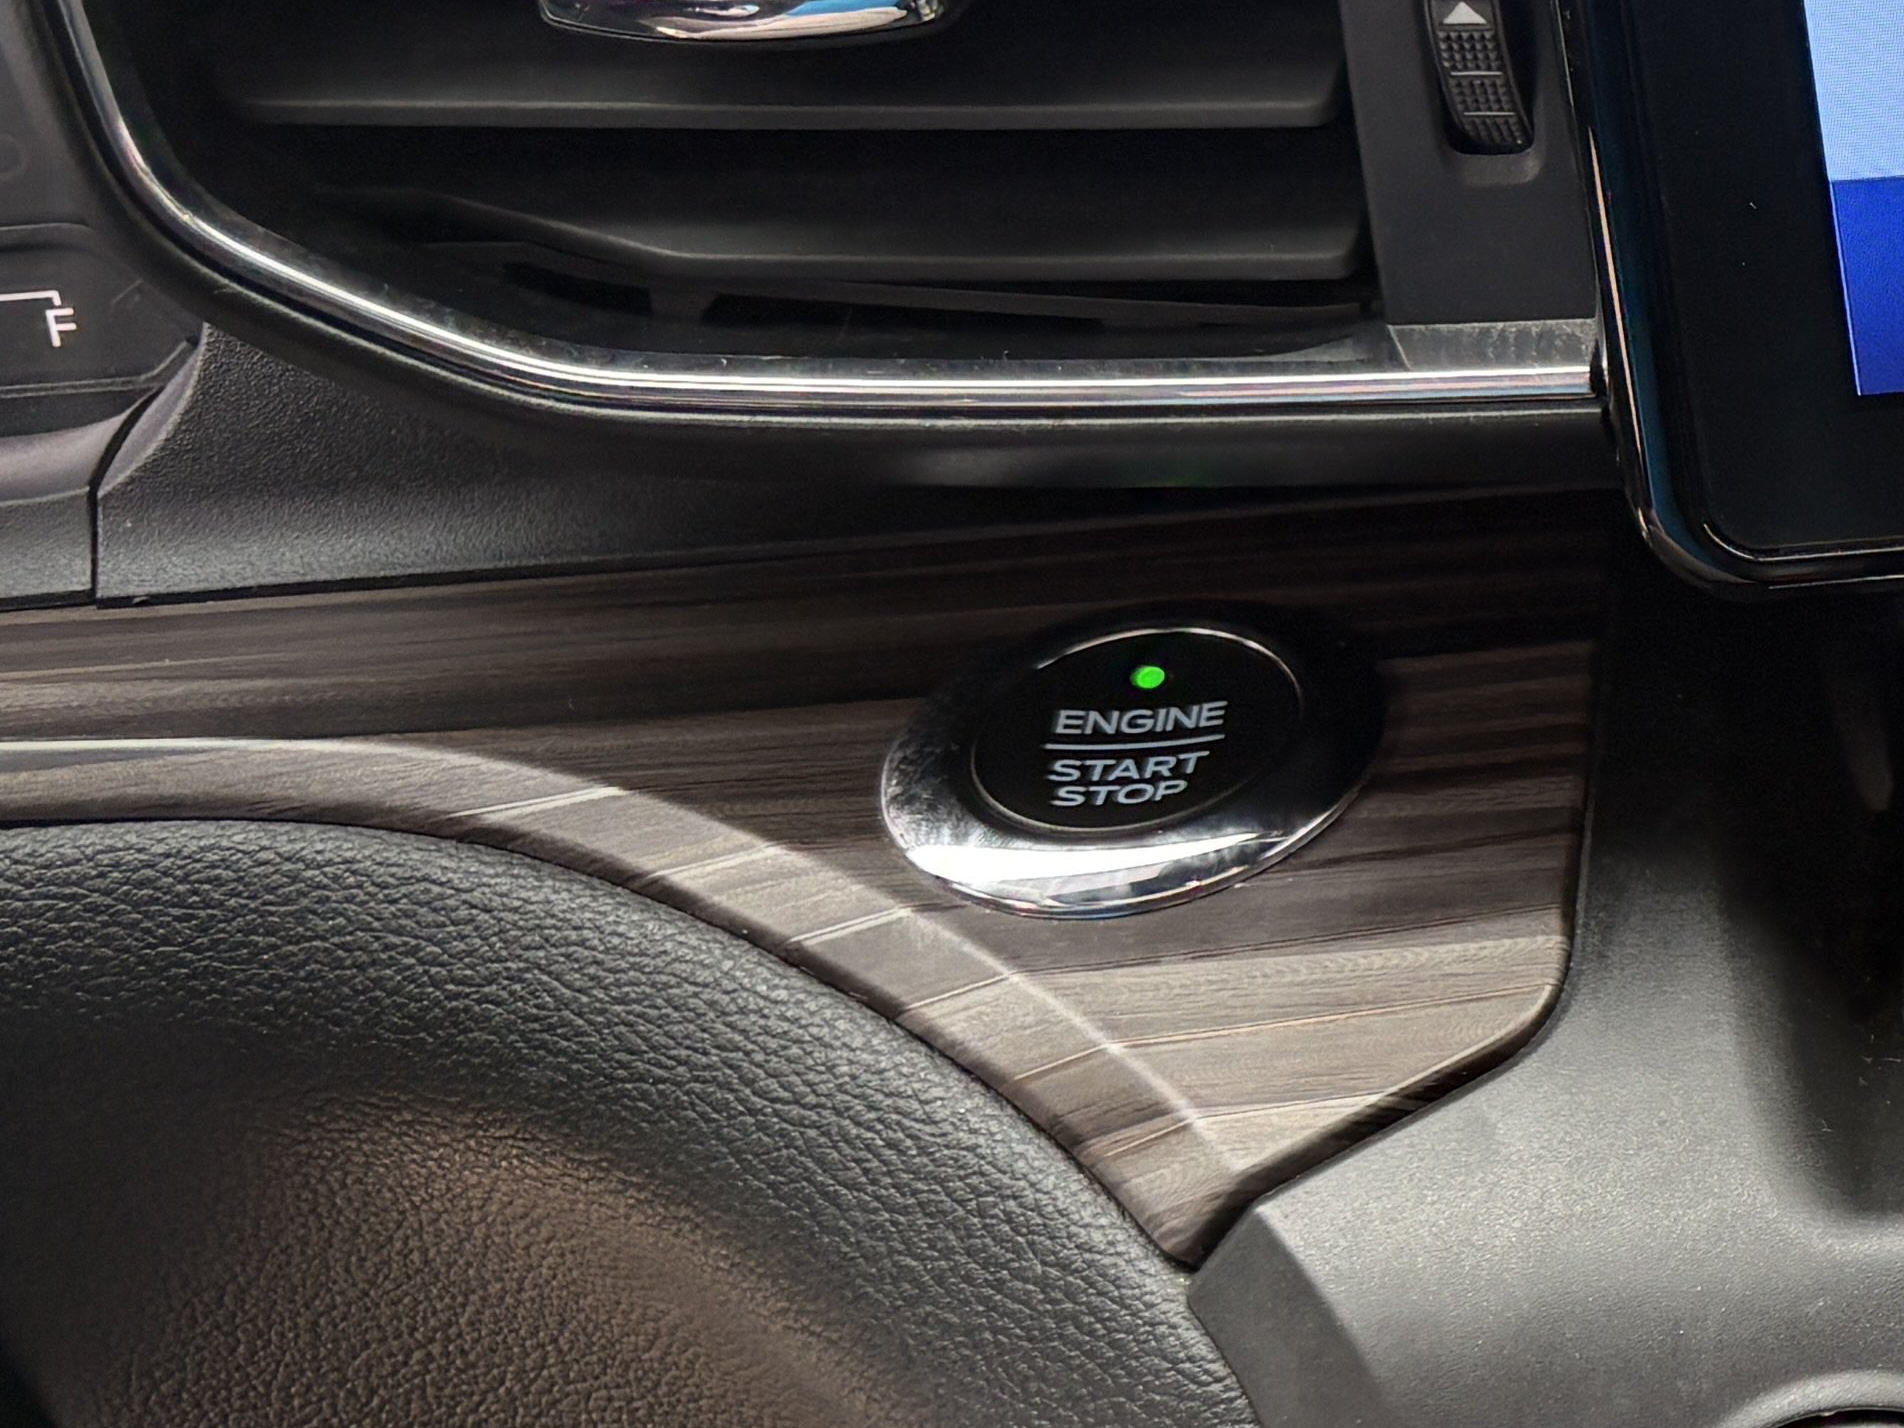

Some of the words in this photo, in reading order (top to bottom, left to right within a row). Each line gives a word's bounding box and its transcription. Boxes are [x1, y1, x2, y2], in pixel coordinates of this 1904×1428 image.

[45, 307, 77, 348] F
[1054, 700, 1229, 736] ENGINE
[1047, 749, 1211, 783] START
[1050, 778, 1189, 808] STOP
